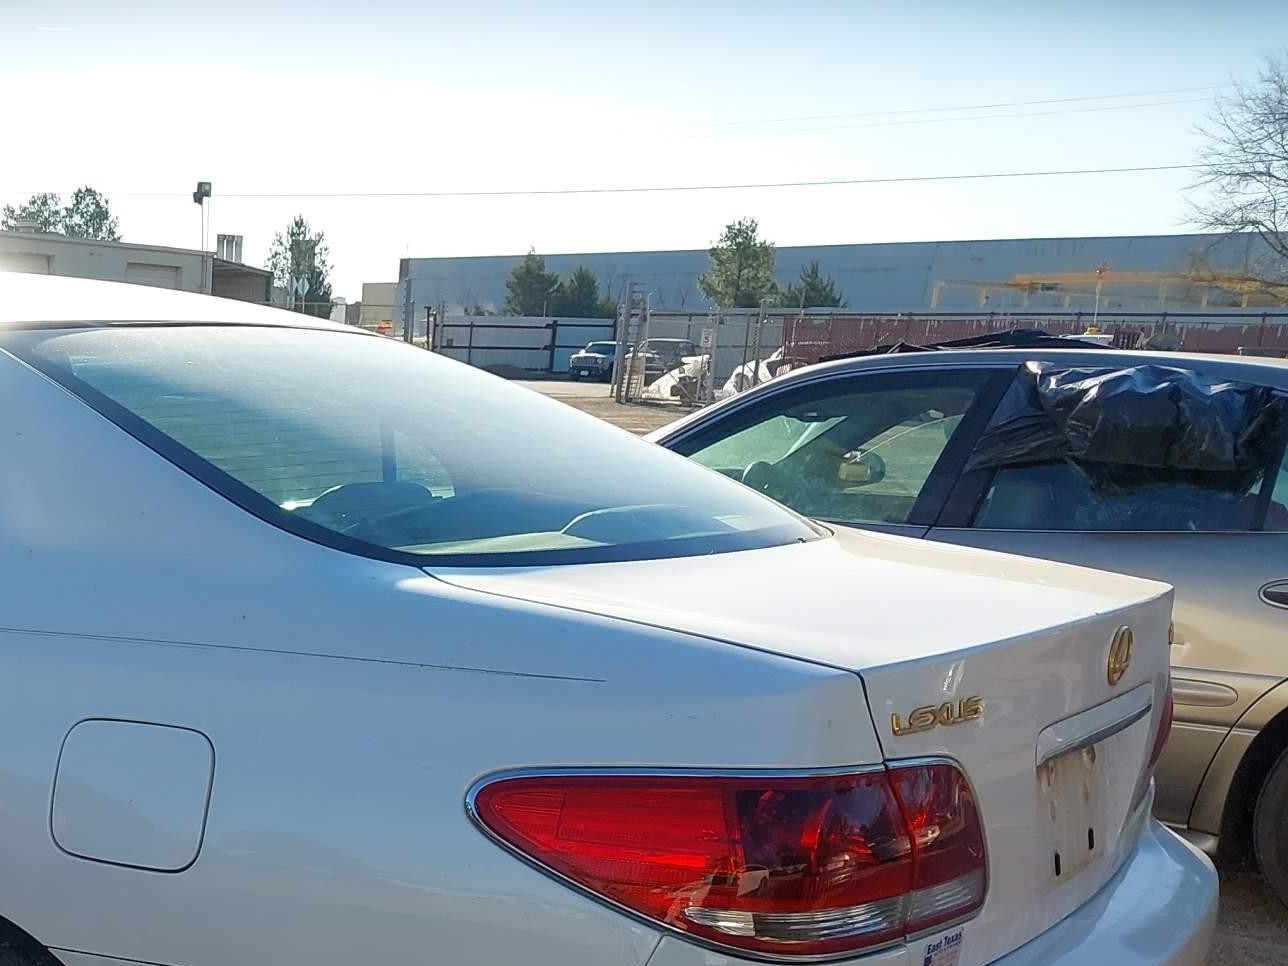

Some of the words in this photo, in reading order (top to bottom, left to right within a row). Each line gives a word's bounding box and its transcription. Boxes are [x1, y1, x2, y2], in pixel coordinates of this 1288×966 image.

[891, 696, 984, 736] LEXUS
[927, 940, 942, 955] East
[944, 931, 962, 946] Texas
